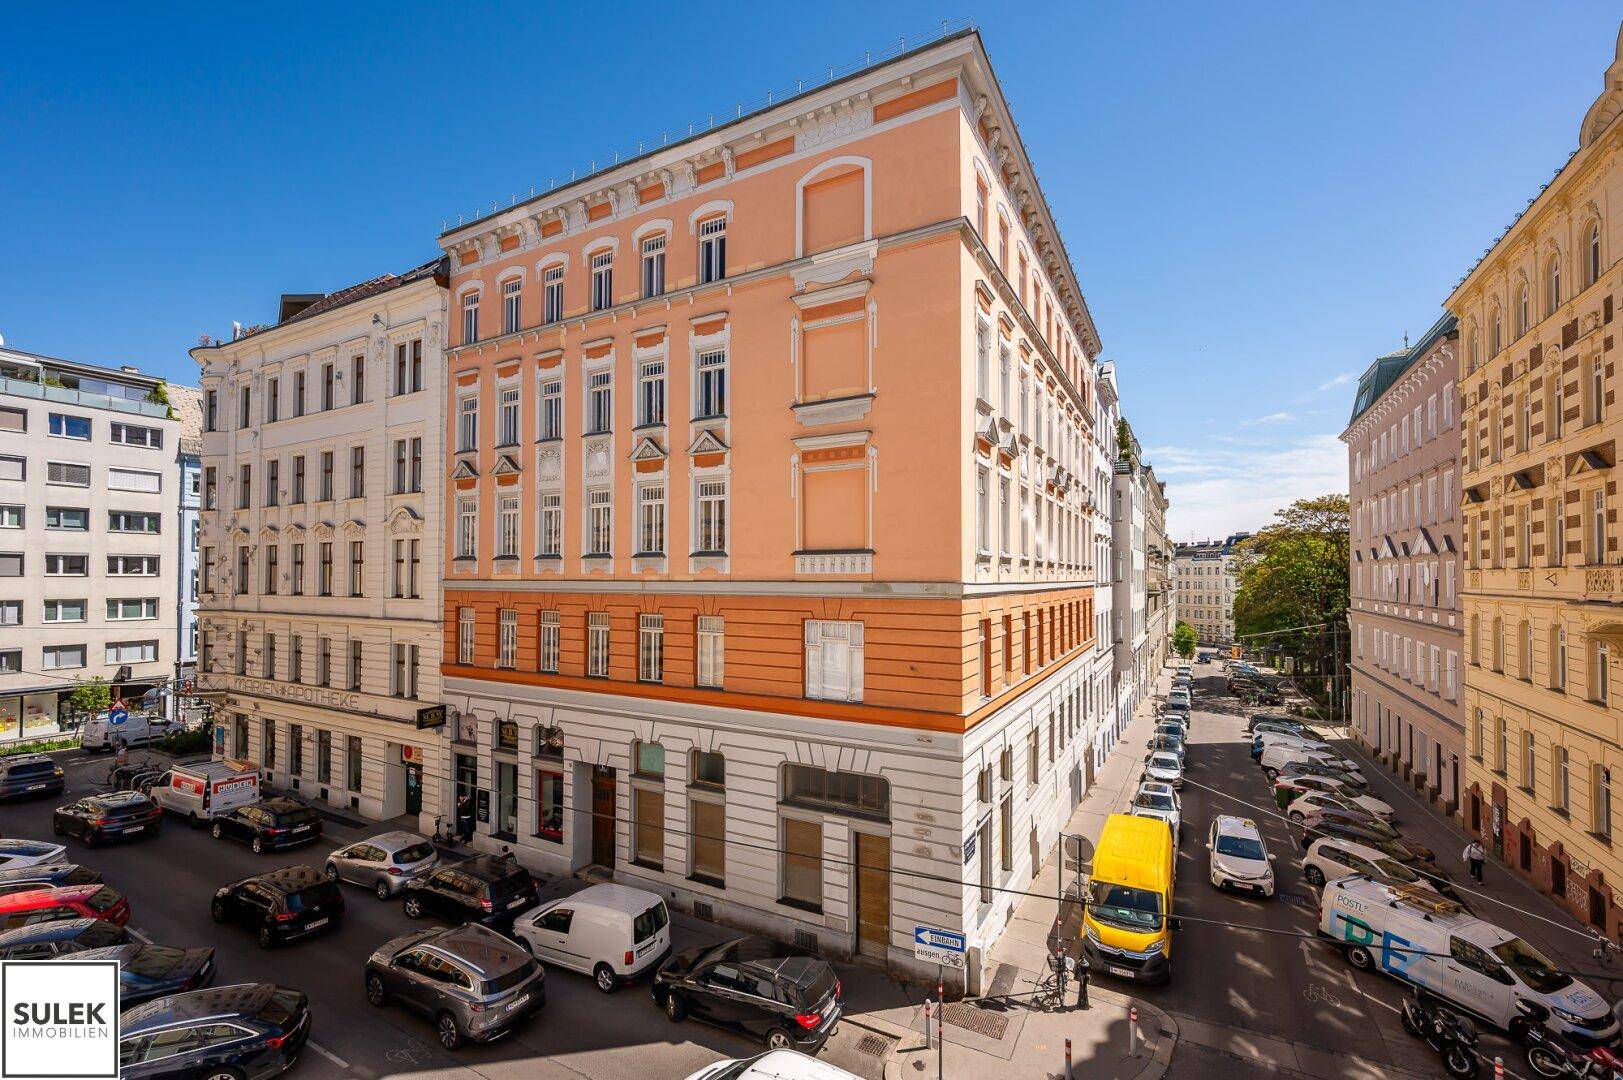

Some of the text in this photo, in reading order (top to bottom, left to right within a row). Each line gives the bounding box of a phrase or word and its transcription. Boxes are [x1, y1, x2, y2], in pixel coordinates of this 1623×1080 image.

[234, 678, 360, 709] MARIEN APOTHEKE
[930, 934, 959, 947] EINBAHN
